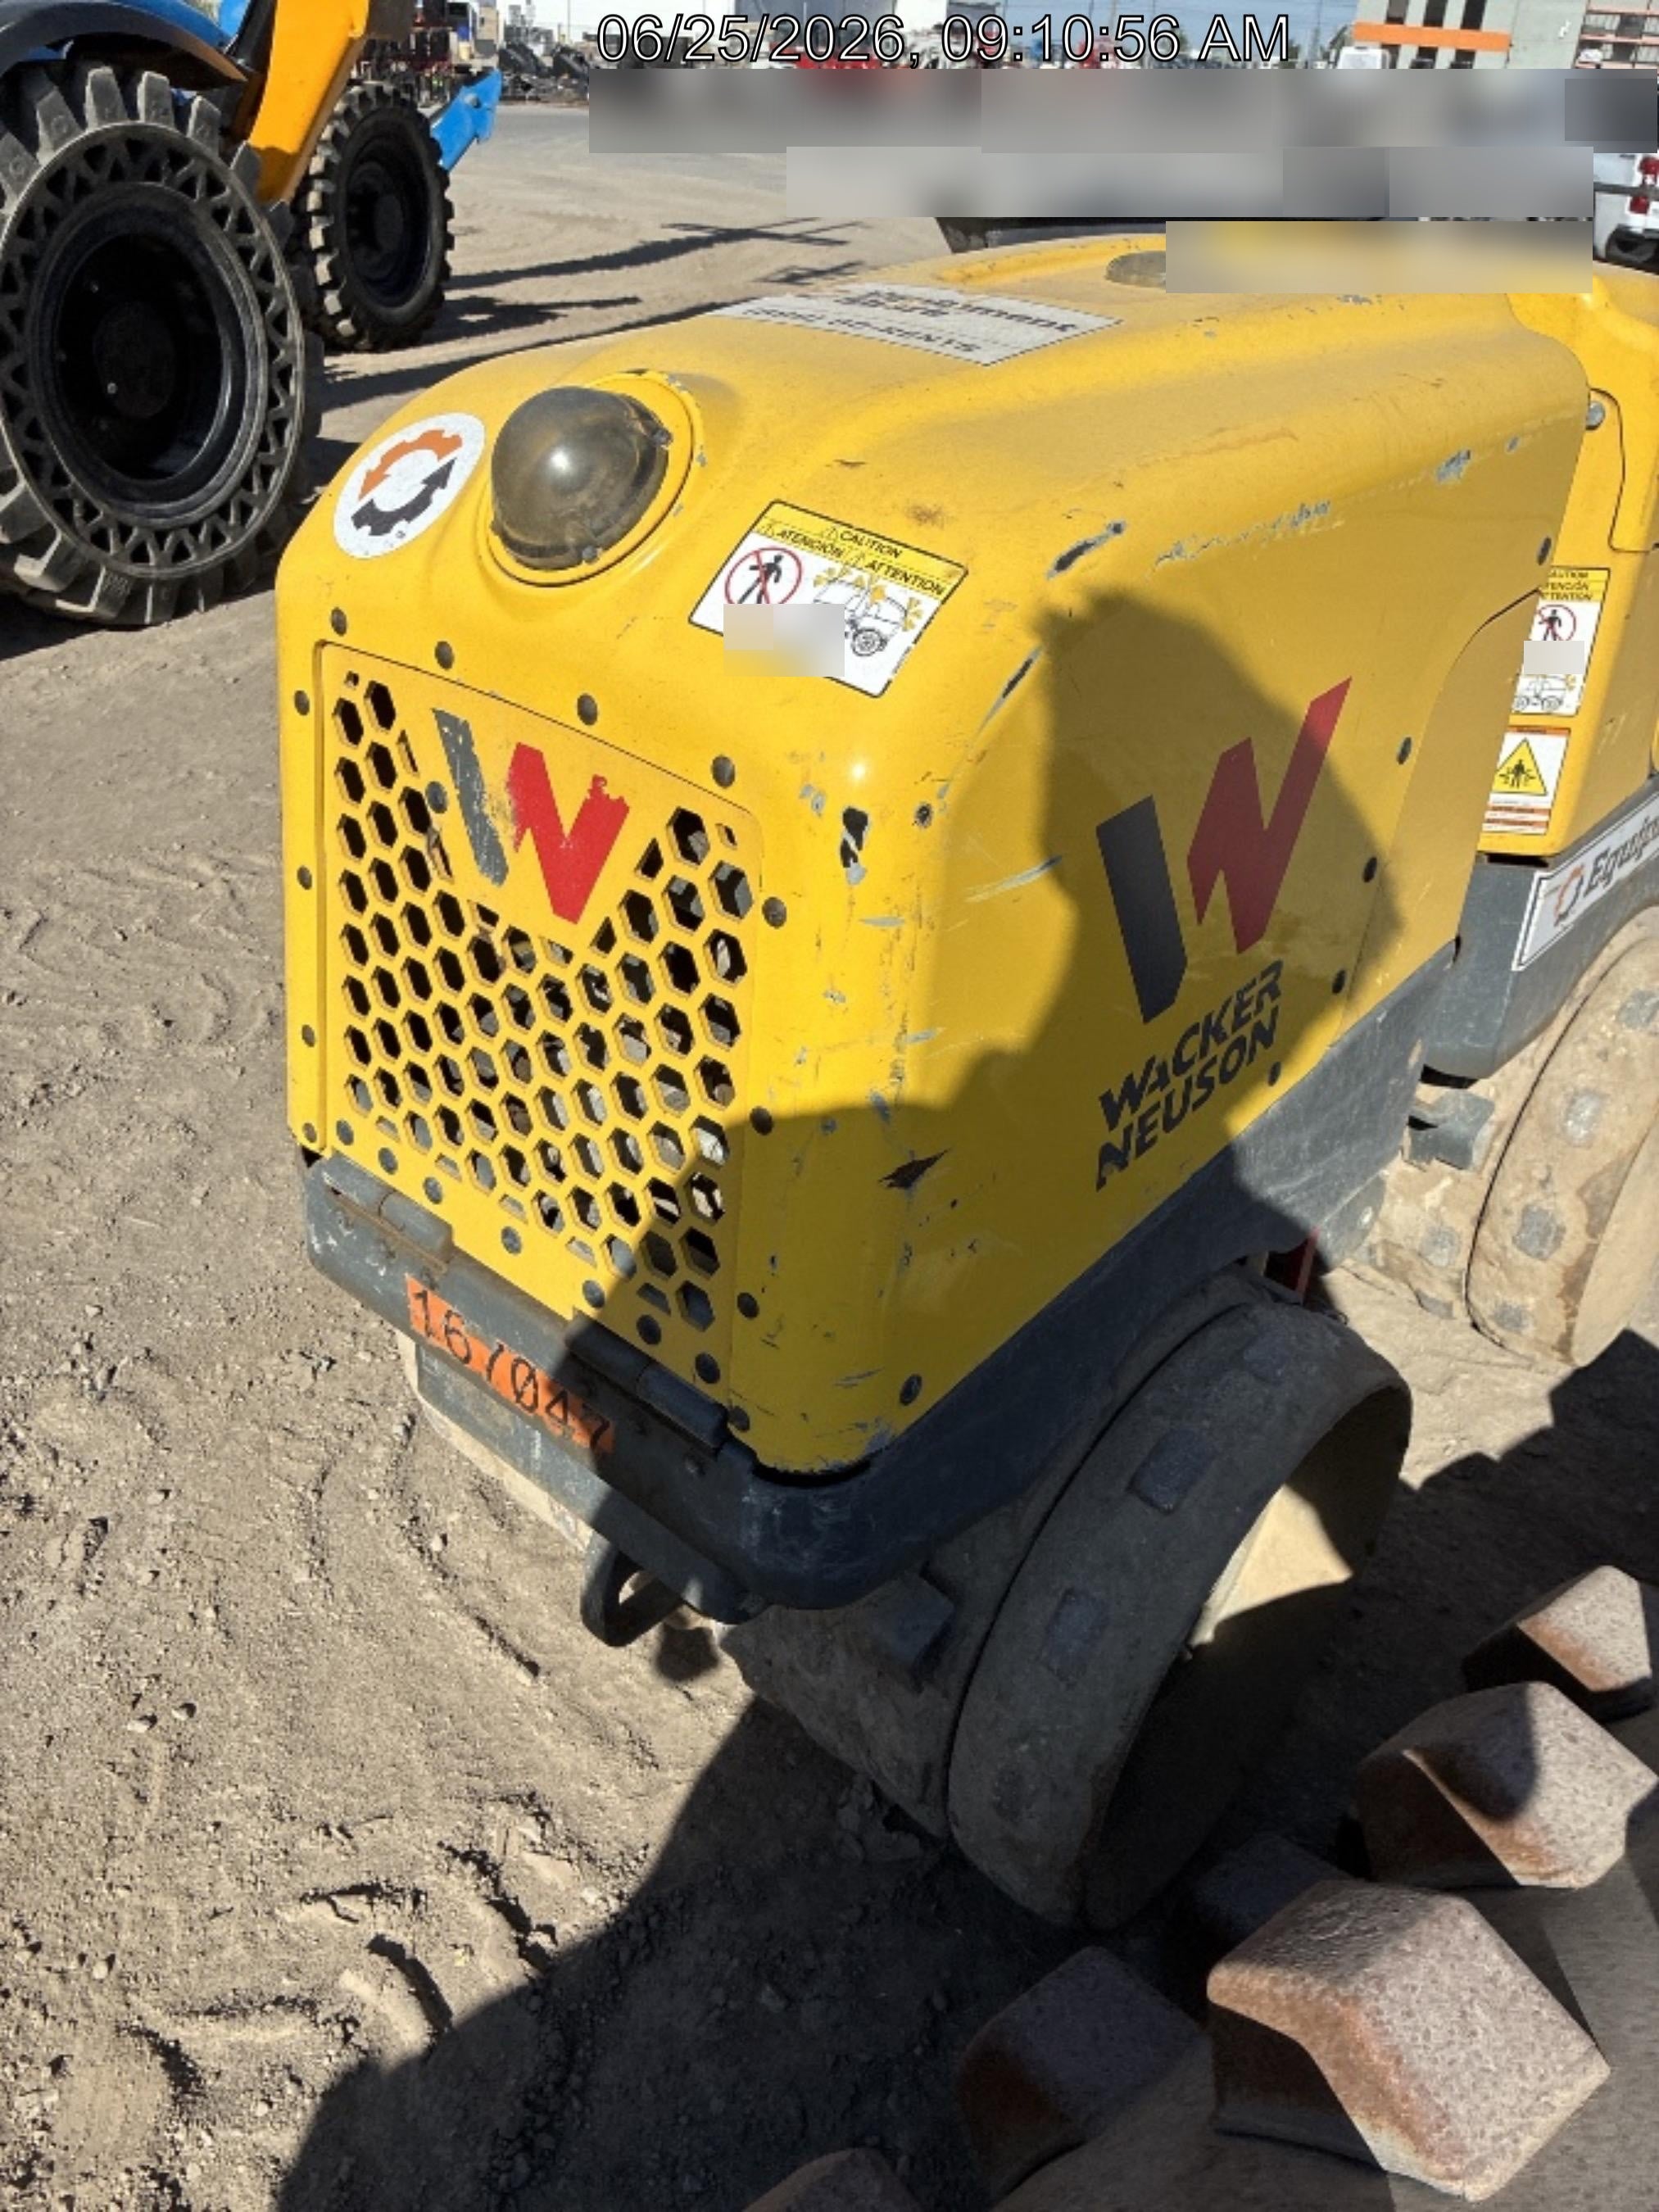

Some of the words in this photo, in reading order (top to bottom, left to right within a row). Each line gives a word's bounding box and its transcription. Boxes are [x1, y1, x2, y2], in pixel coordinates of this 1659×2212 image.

[777, 530, 844, 559] ATENCIÓN
[840, 531, 903, 559] CAUTION
[865, 560, 945, 595] ATTENTION
[1098, 959, 1283, 1132] WACKER
[1096, 1007, 1280, 1192] NEUSON
